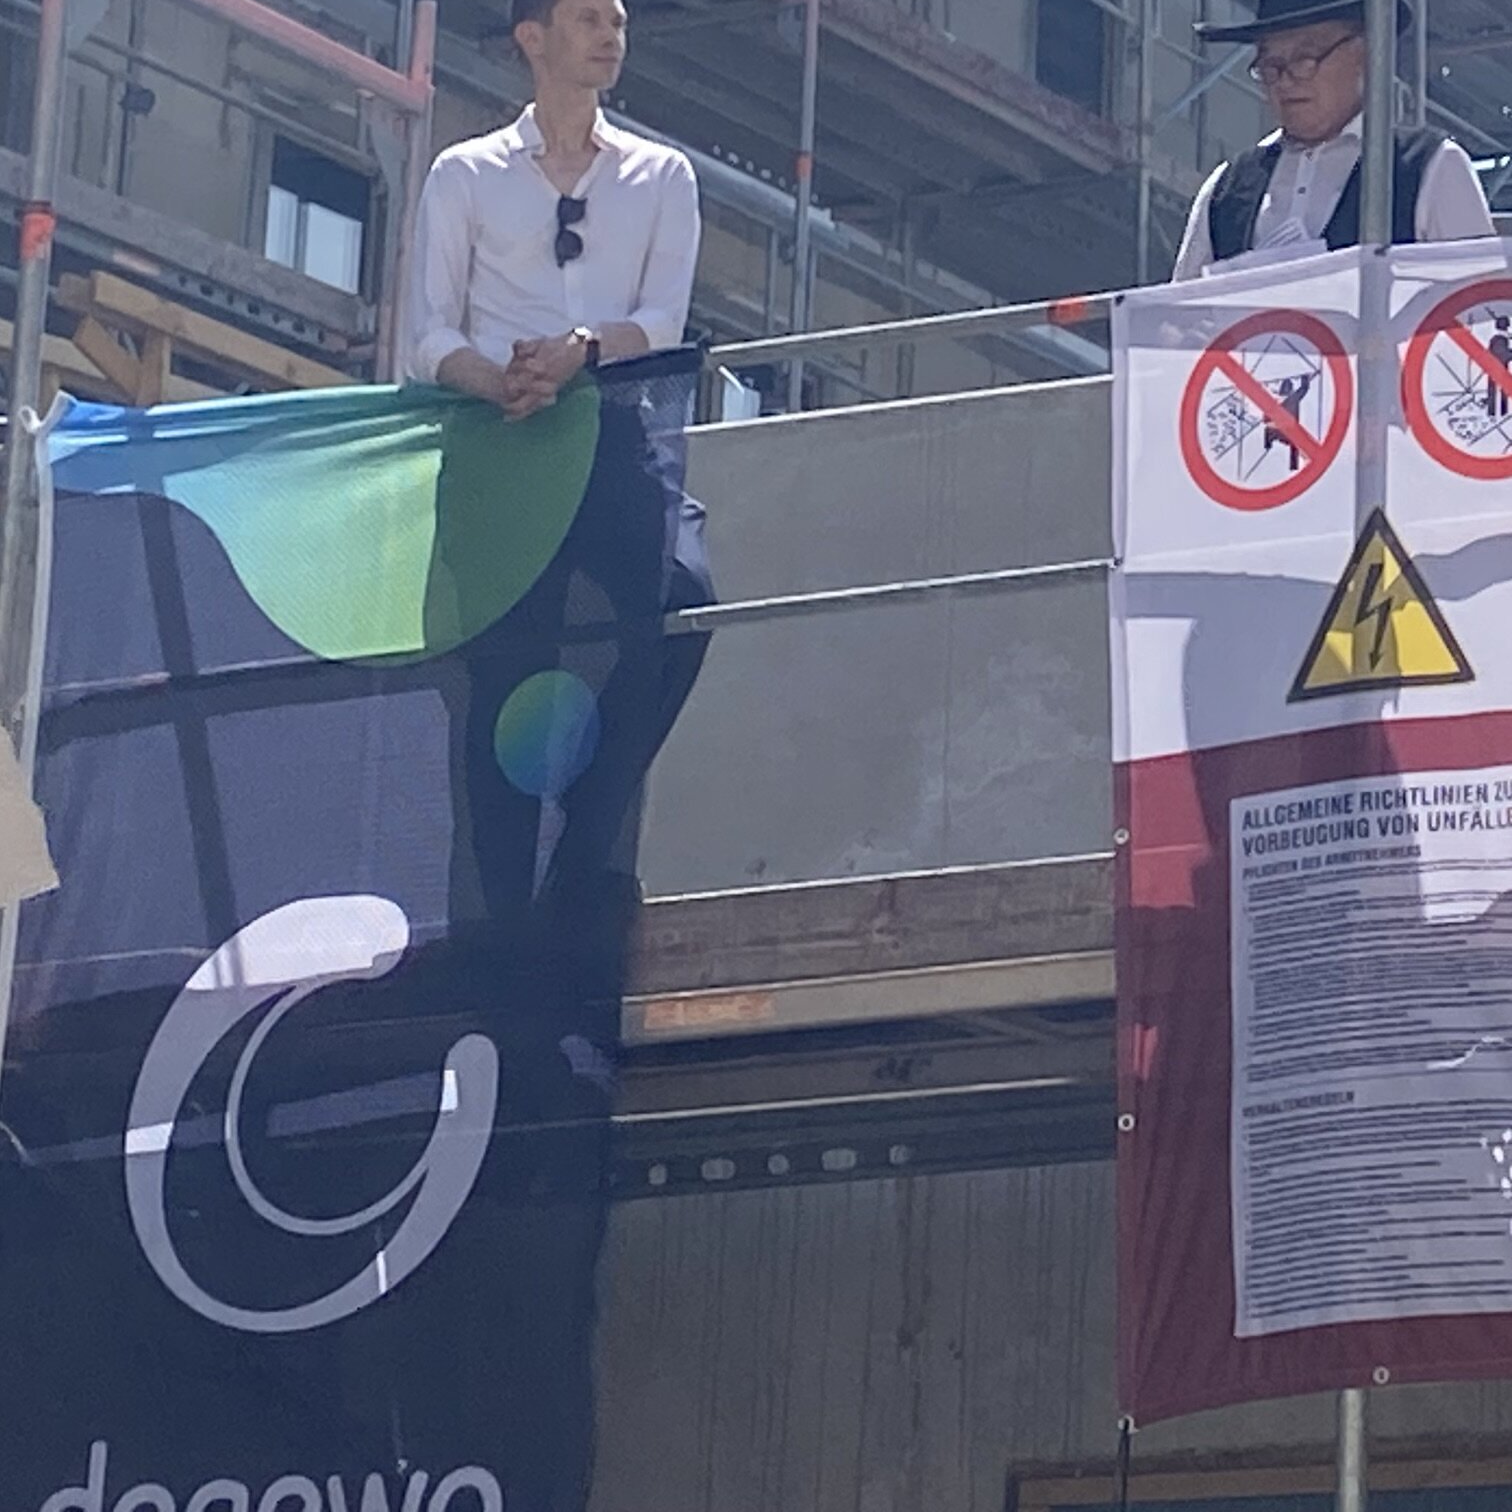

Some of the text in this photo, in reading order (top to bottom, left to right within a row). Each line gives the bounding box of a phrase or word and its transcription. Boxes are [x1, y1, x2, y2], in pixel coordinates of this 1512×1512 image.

[1241, 792, 1354, 831] ALLGEMEINE
[1359, 781, 1489, 811] RICHTLINIEN
[1241, 817, 1370, 856] VORBEUGUNG
[1376, 813, 1420, 837] VON
